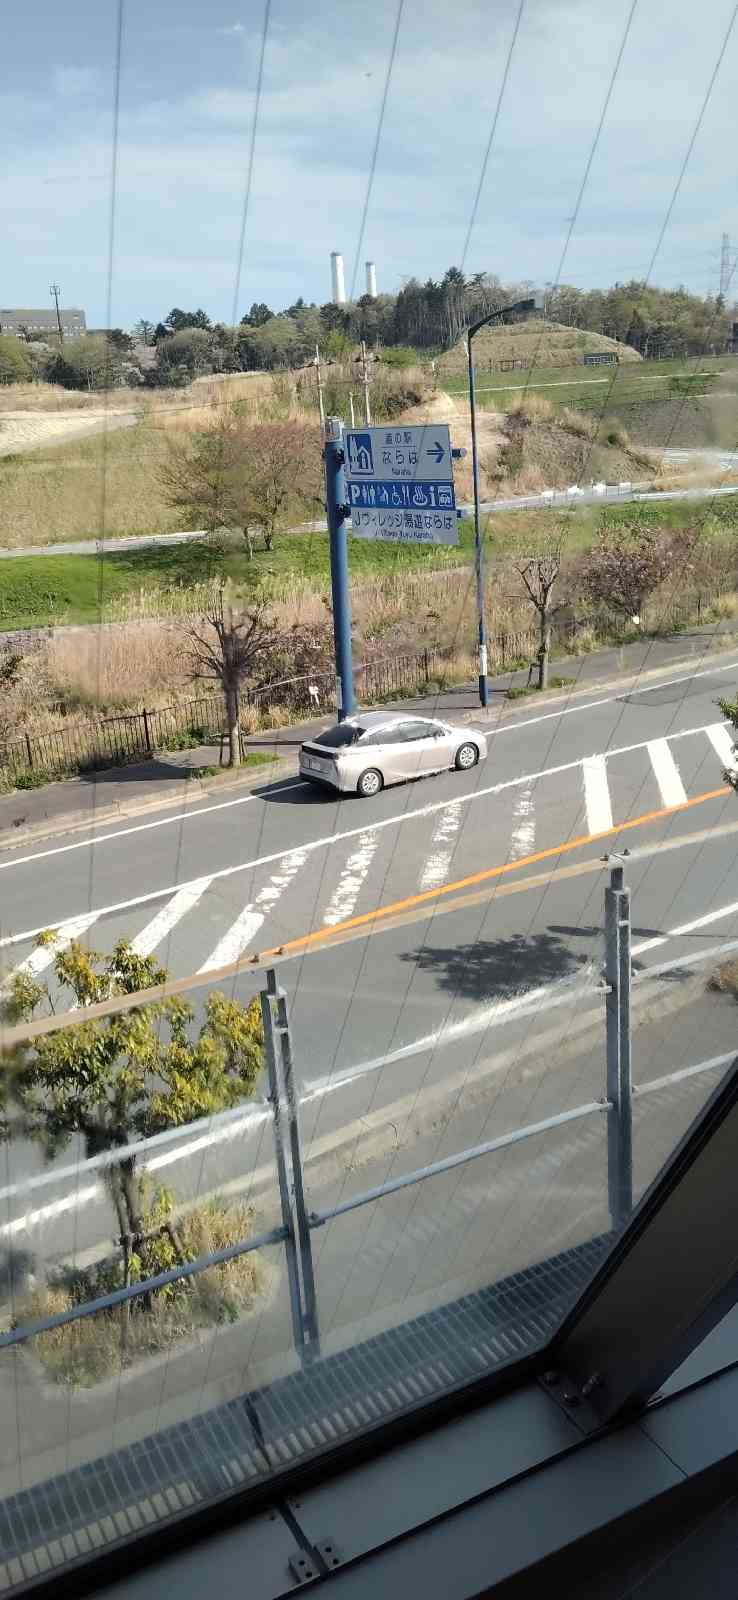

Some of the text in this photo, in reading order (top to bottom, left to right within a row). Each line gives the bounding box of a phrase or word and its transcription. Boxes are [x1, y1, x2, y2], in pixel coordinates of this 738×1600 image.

[385, 432, 413, 444] 道の駅
[382, 449, 418, 464] ならは
